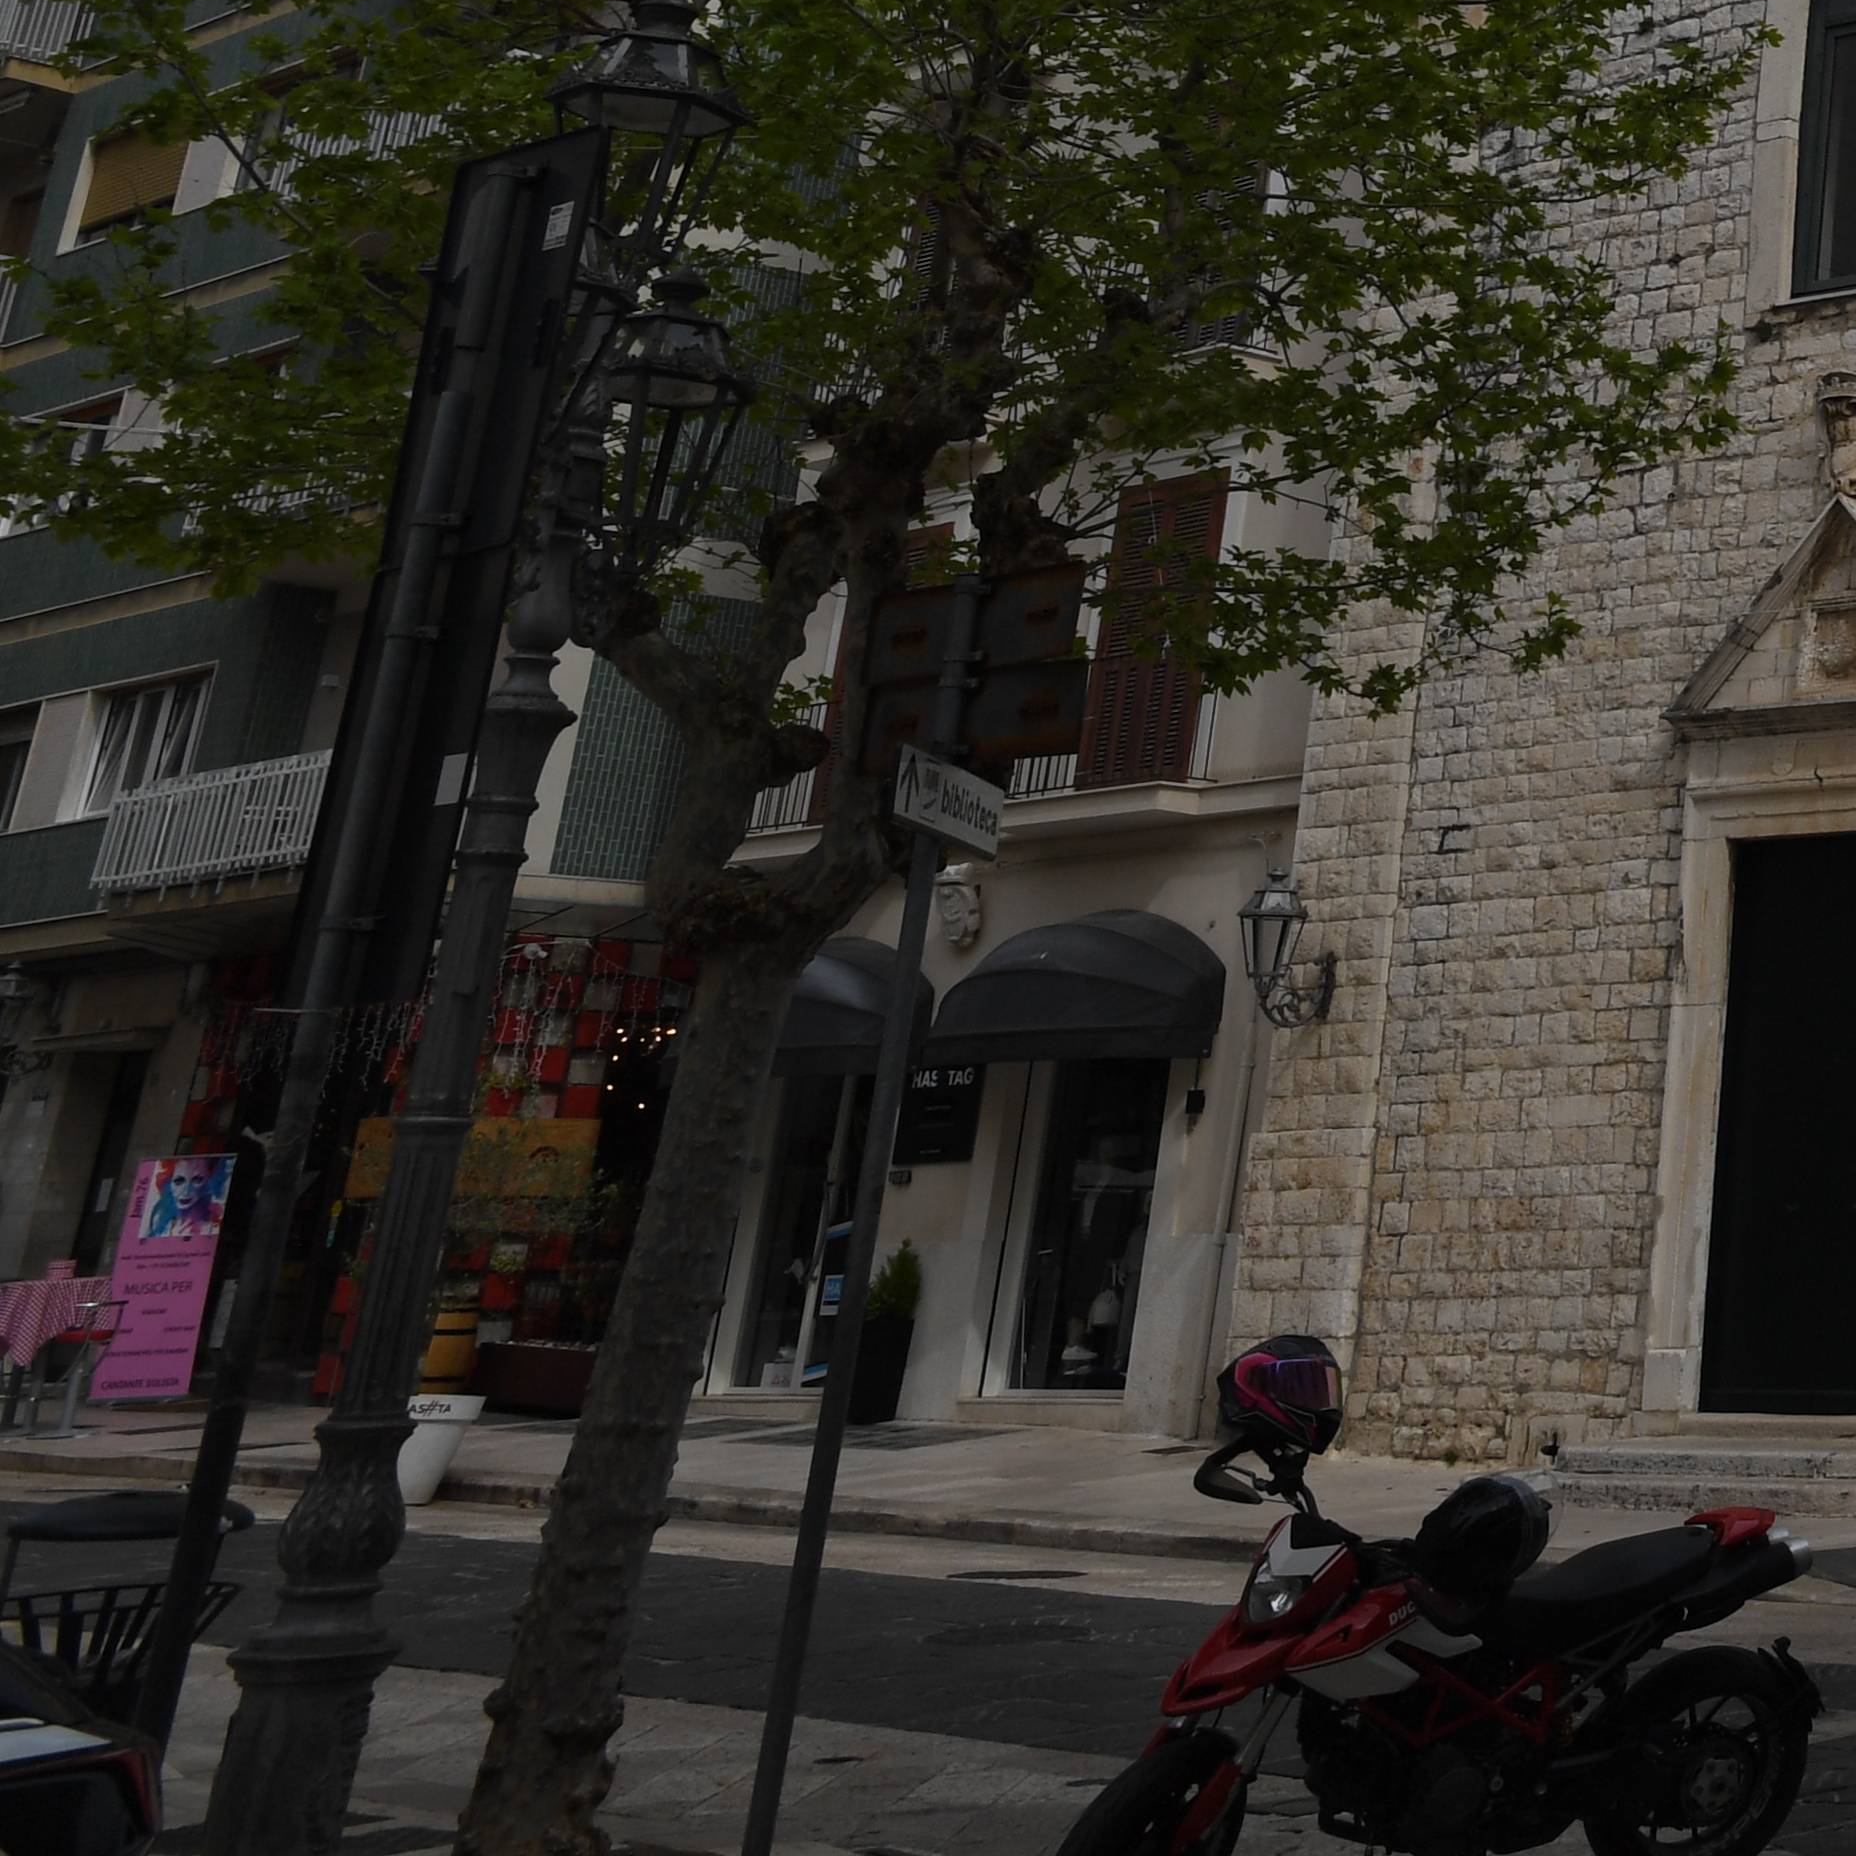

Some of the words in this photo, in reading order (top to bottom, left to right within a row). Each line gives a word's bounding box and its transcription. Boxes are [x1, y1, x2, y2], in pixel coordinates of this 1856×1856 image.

[940, 779, 998, 836] biblioteca
[123, 1282, 169, 1295] MUSICA
[170, 1280, 193, 1293] PER
[1388, 1600, 1416, 1626] DUC
